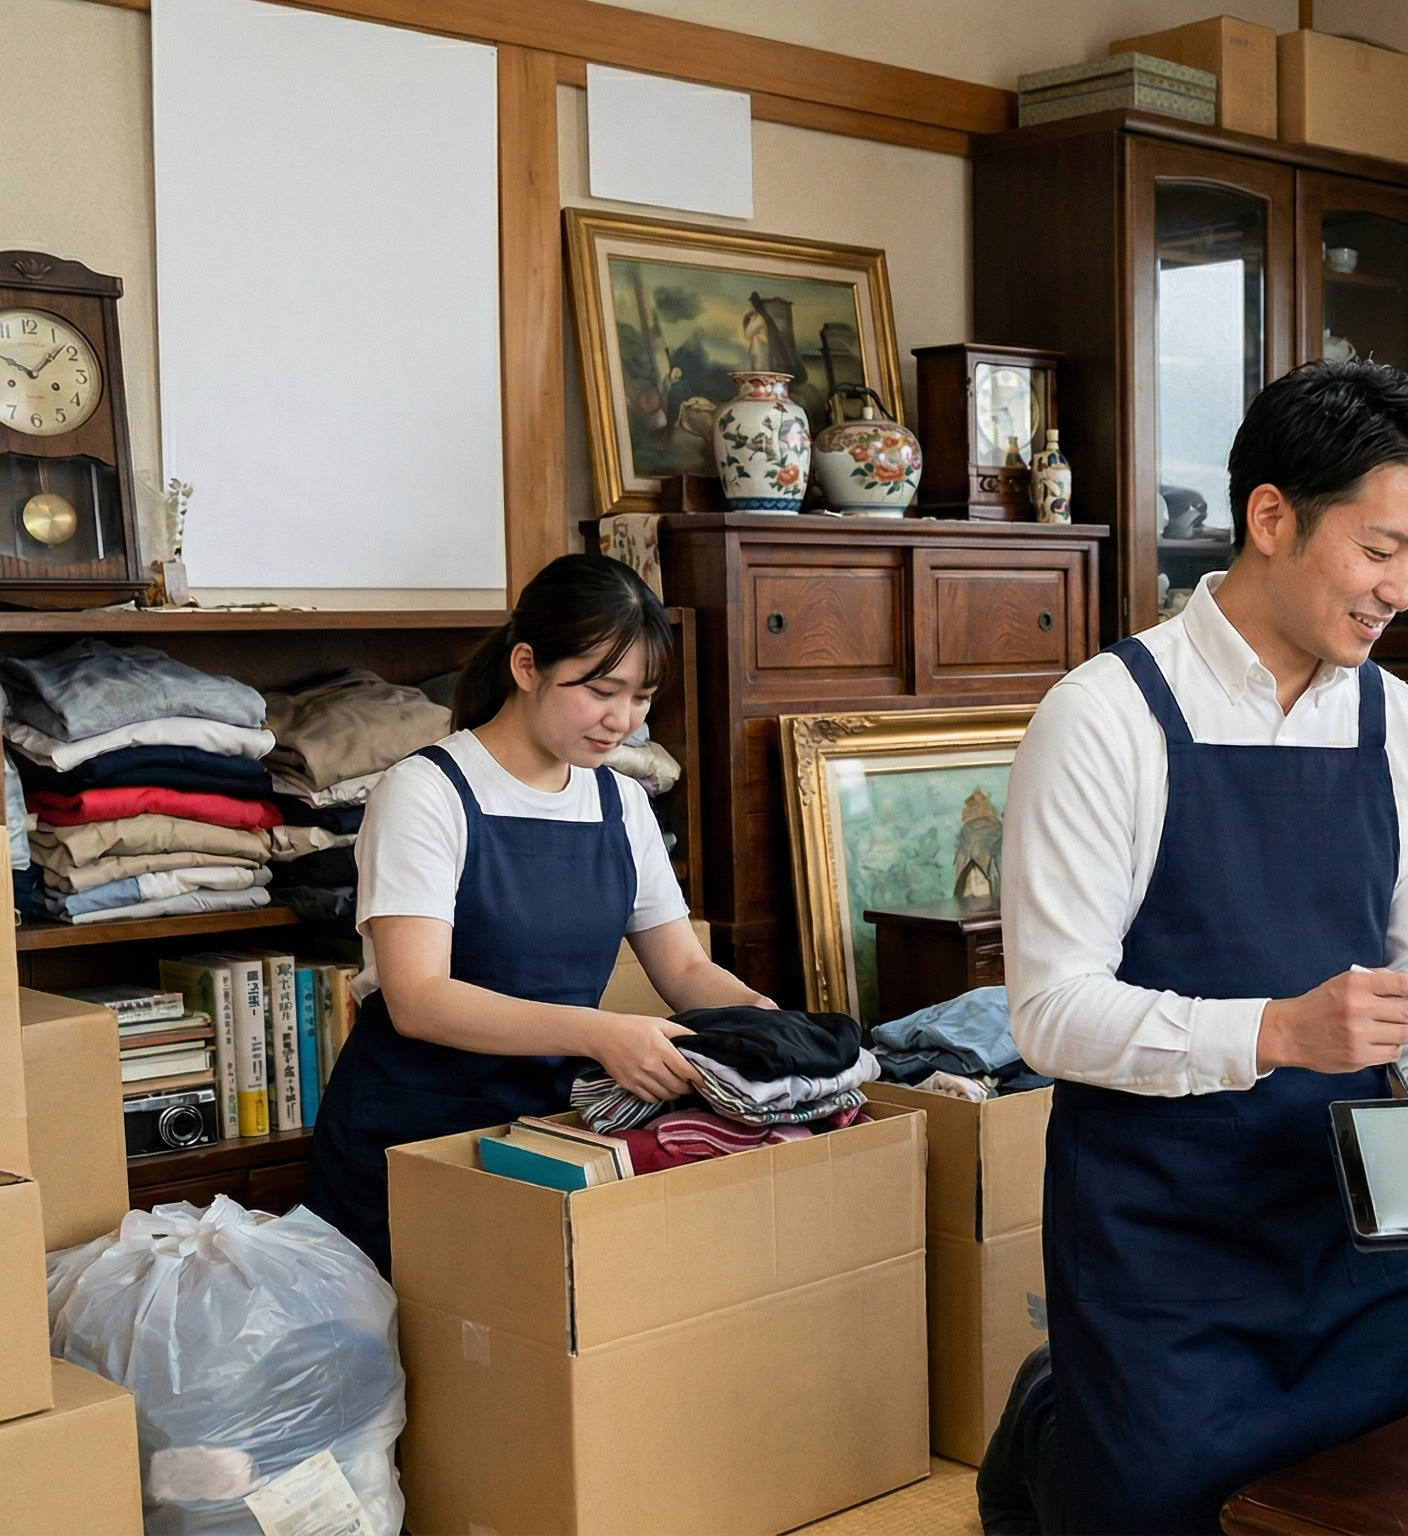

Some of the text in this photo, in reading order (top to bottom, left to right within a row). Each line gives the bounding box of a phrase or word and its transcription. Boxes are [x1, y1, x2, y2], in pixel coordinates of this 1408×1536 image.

[22, 319, 38, 335] 12
[51, 328, 56, 344] 1
[66, 345, 79, 361] 2
[75, 369, 88, 385] 3
[69, 391, 81, 407] 4
[6, 404, 18, 419] 7
[55, 408, 67, 423] 5
[30, 413, 43, 428] 6
